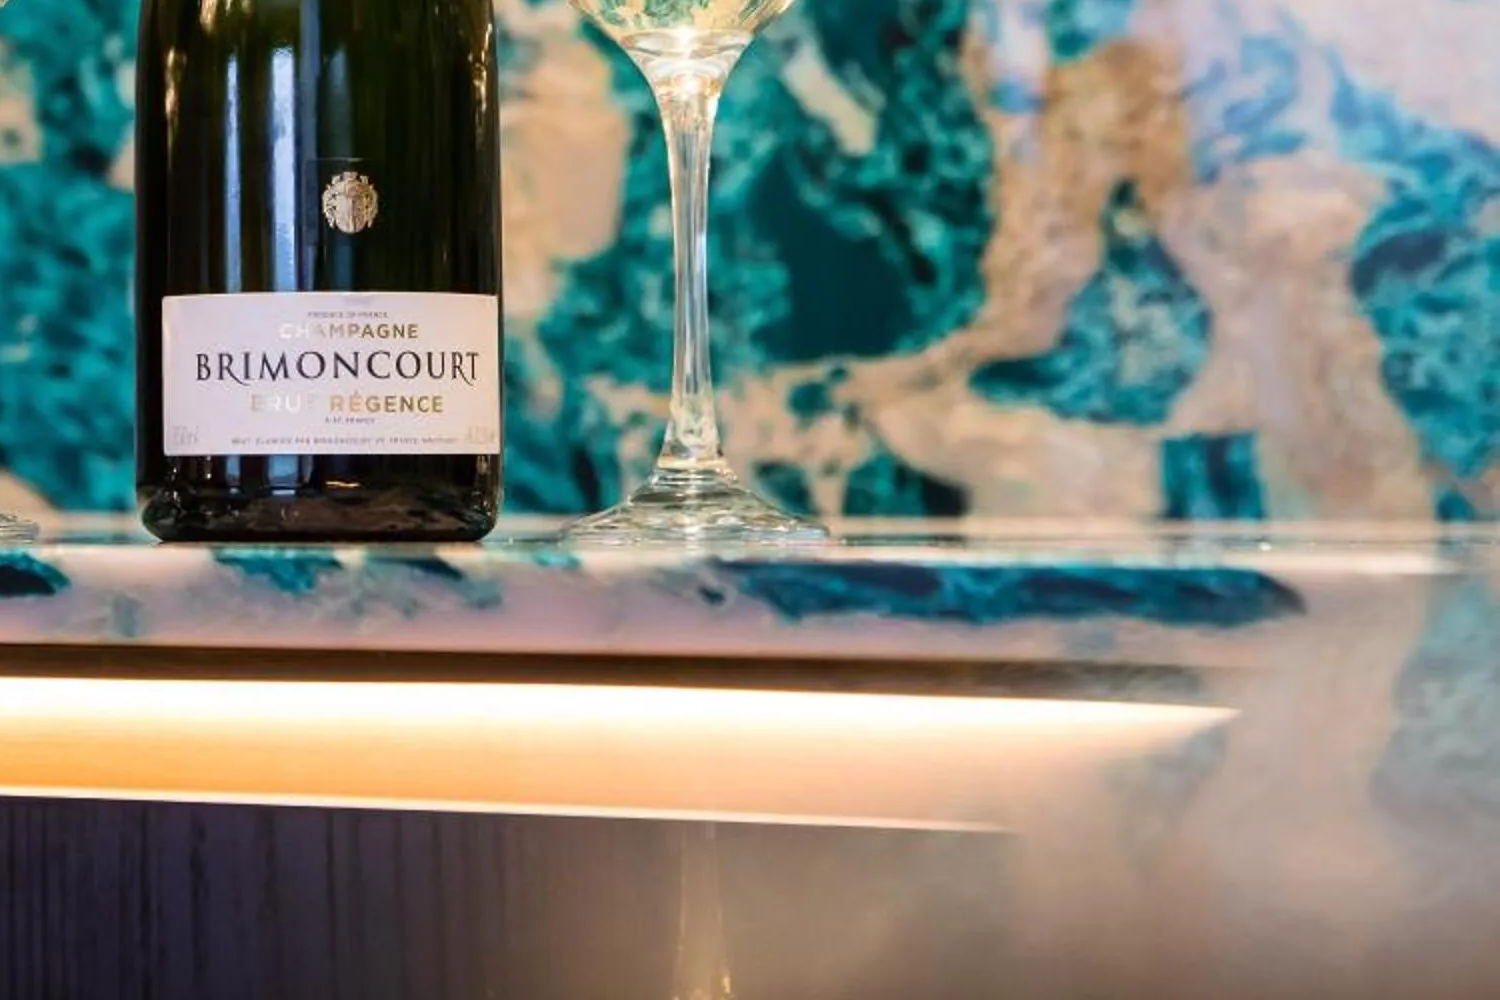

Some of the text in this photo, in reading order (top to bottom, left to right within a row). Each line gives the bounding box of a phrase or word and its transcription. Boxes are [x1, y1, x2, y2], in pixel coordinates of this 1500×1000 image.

[279, 322, 419, 340] CHAMPAGNE
[195, 350, 480, 387] BRIMONCOURT
[329, 389, 444, 413] RÉGENCE
